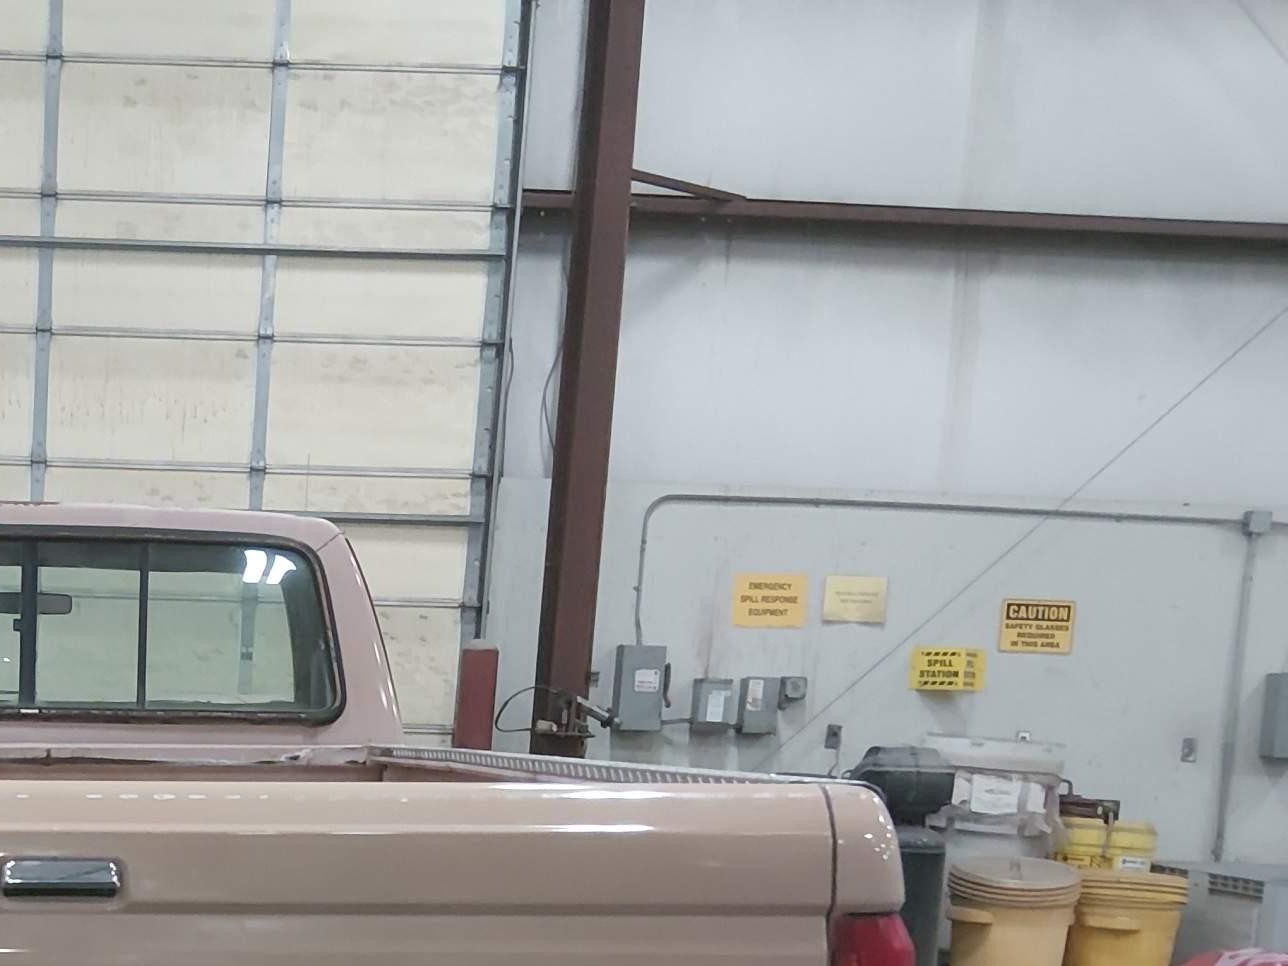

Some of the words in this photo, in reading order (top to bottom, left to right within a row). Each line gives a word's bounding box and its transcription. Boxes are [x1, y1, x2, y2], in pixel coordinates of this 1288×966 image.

[748, 582, 792, 591] EMERGENCY
[740, 594, 759, 604] SPILL
[761, 595, 799, 604] RESPONSE
[748, 608, 789, 617] EQUIPMENT
[1009, 604, 1069, 621] CAUTION
[1005, 622, 1033, 630] SAFETY
[1017, 631, 1056, 639] REQUIRED
[1021, 640, 1038, 648] THIS
[1040, 641, 1060, 649] AREA
[927, 658, 953, 668] SPILL
[919, 669, 960, 679] STATION
